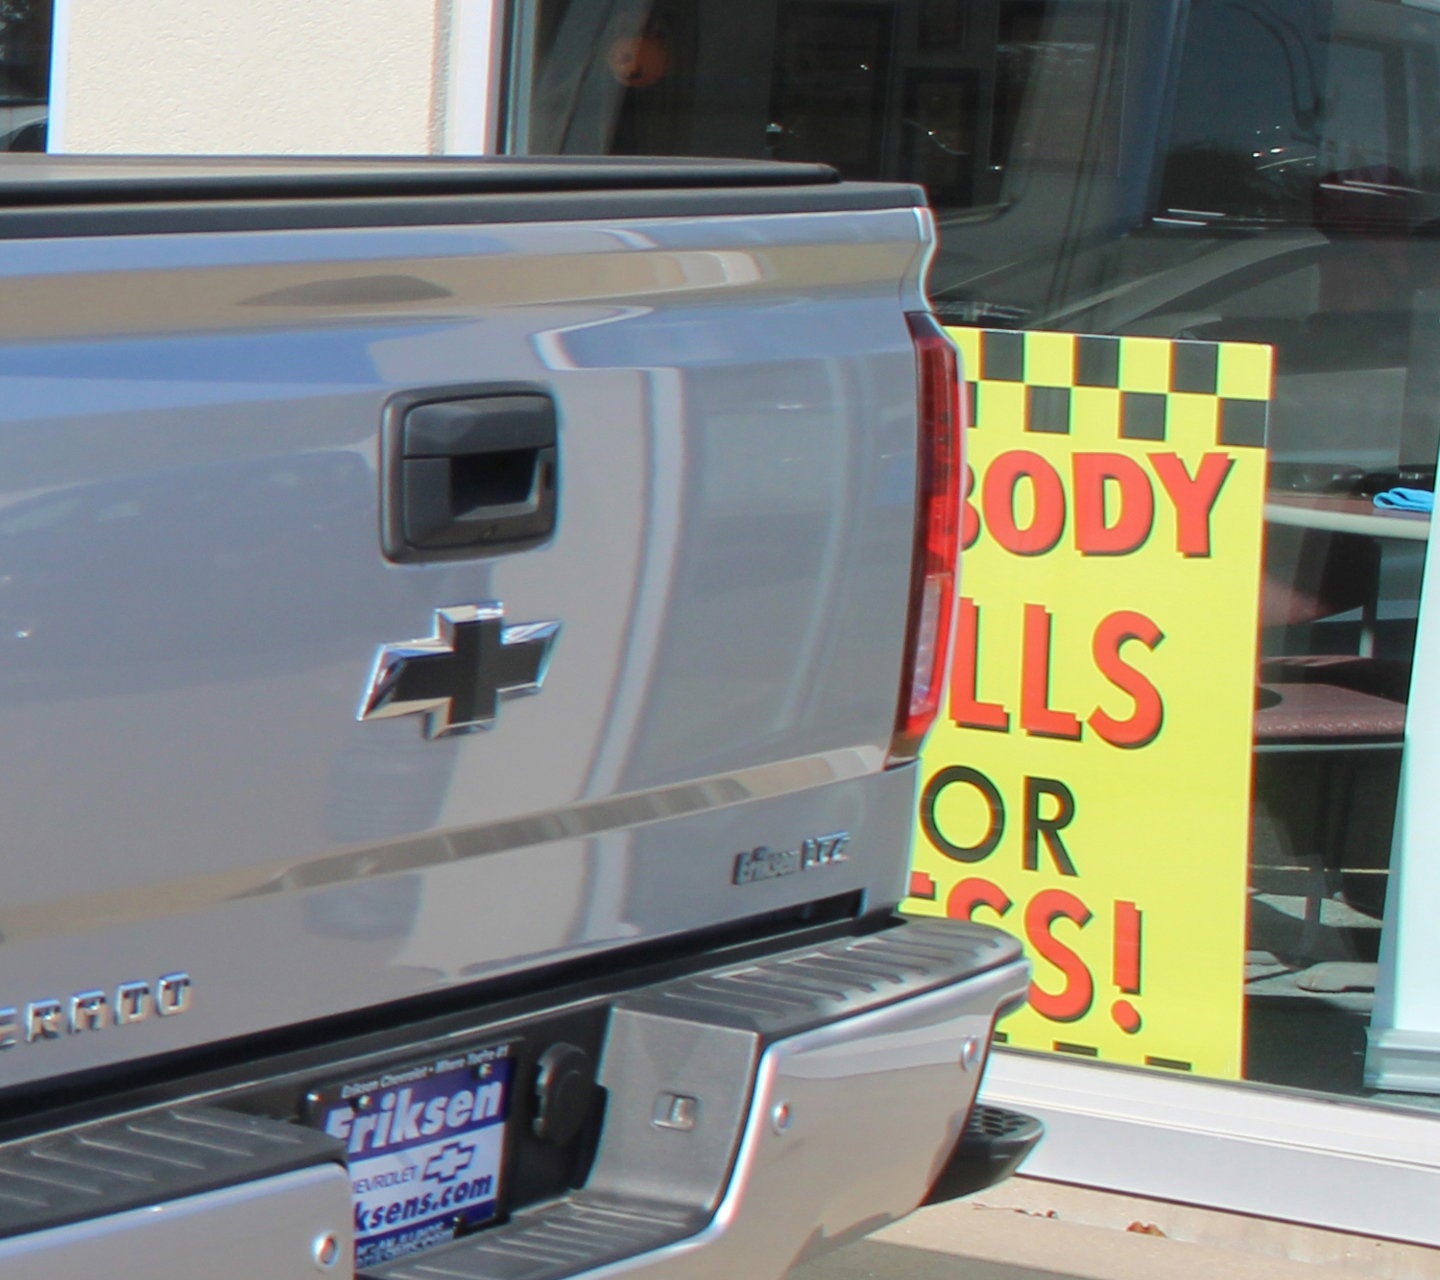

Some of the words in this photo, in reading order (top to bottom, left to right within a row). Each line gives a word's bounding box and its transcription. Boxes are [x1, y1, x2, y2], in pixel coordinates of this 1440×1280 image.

[962, 448, 1235, 558] ODY
[909, 870, 1143, 1035] S!
[325, 1080, 503, 1155] Eriksen
[353, 1165, 418, 1194] EVROLET
